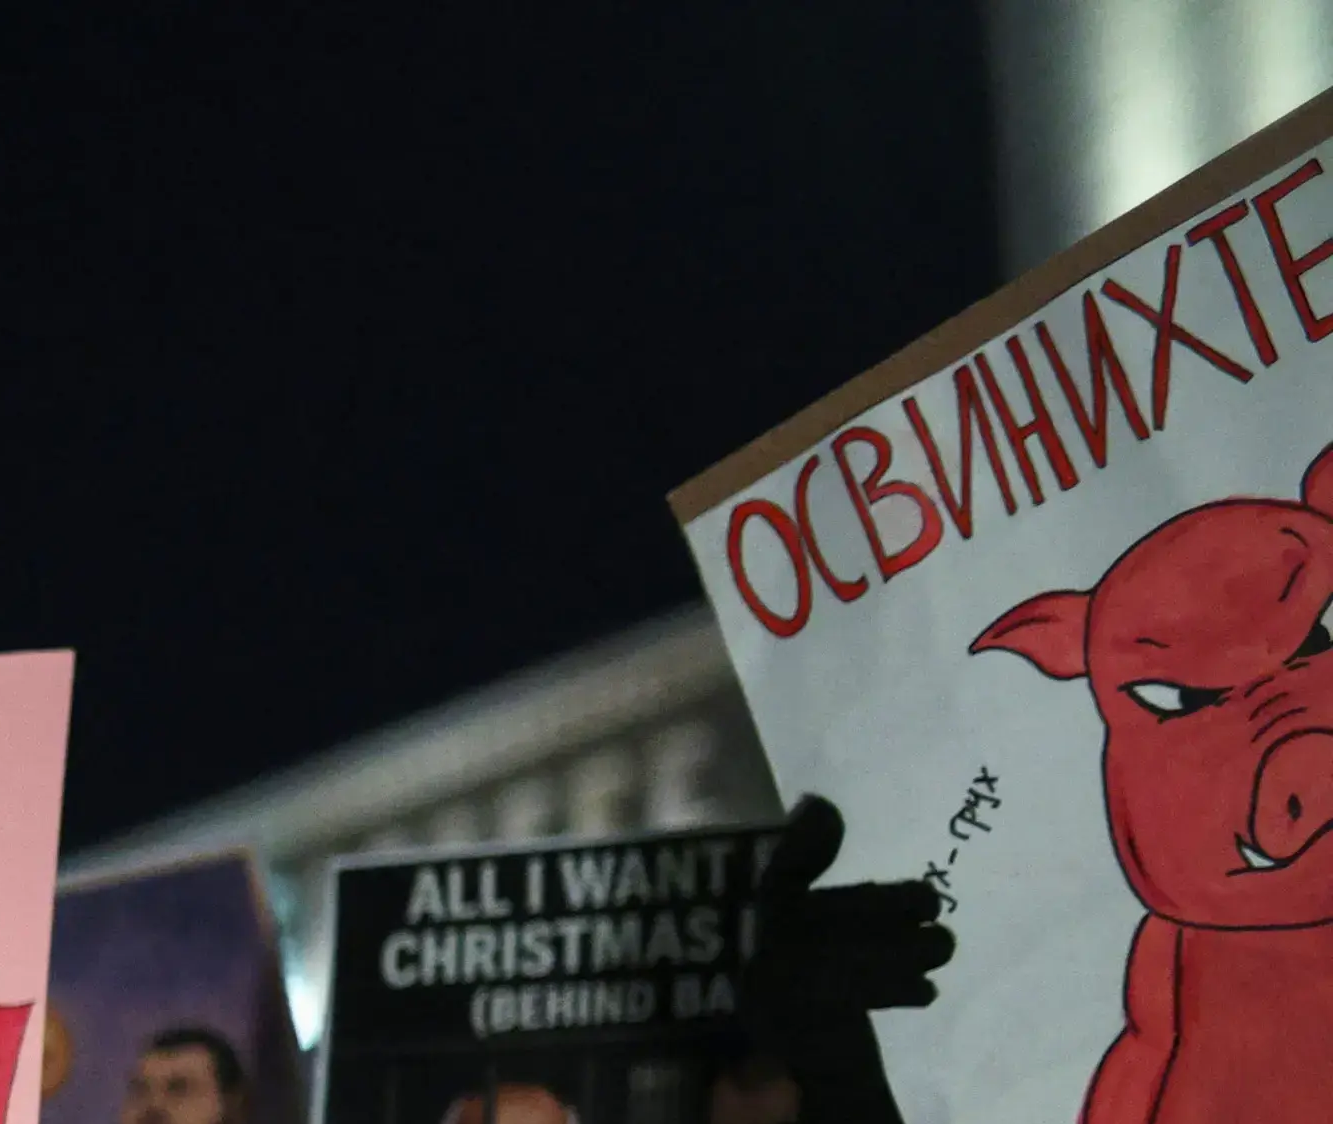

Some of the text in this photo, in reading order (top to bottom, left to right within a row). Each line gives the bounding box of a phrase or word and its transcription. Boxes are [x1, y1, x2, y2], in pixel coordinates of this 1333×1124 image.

[403, 861, 513, 926] ALL
[525, 855, 545, 915] I
[557, 840, 734, 911] WANT
[379, 905, 725, 990] CHRISTMAS
[470, 975, 656, 1039] (BEHIND
